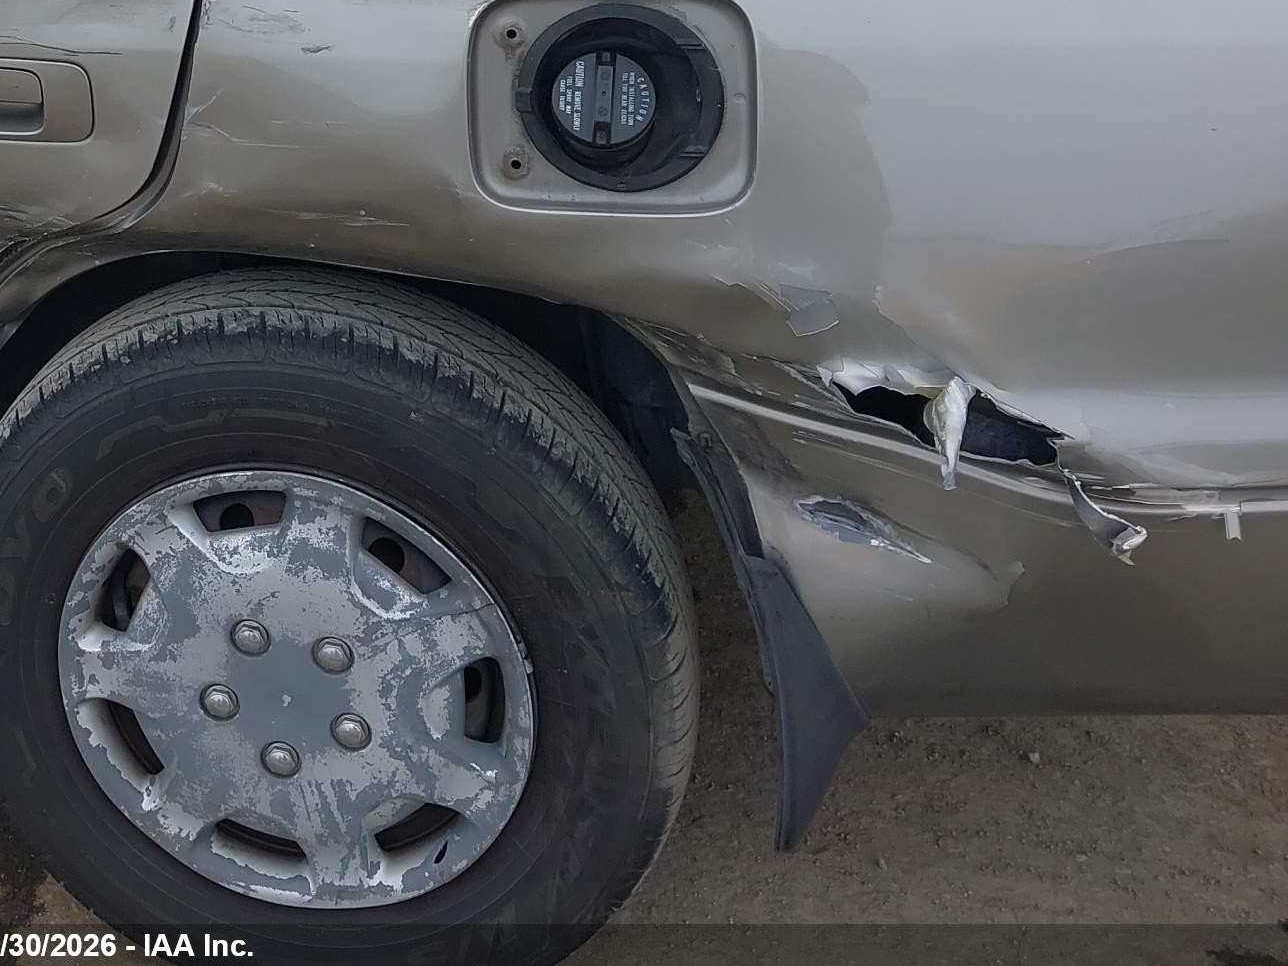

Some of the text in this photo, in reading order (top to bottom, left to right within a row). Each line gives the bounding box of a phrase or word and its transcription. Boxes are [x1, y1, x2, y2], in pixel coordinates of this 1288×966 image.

[575, 61, 585, 87] CAUTION
[574, 91, 582, 110] REMOVE
[635, 77, 649, 122] CAUTION
